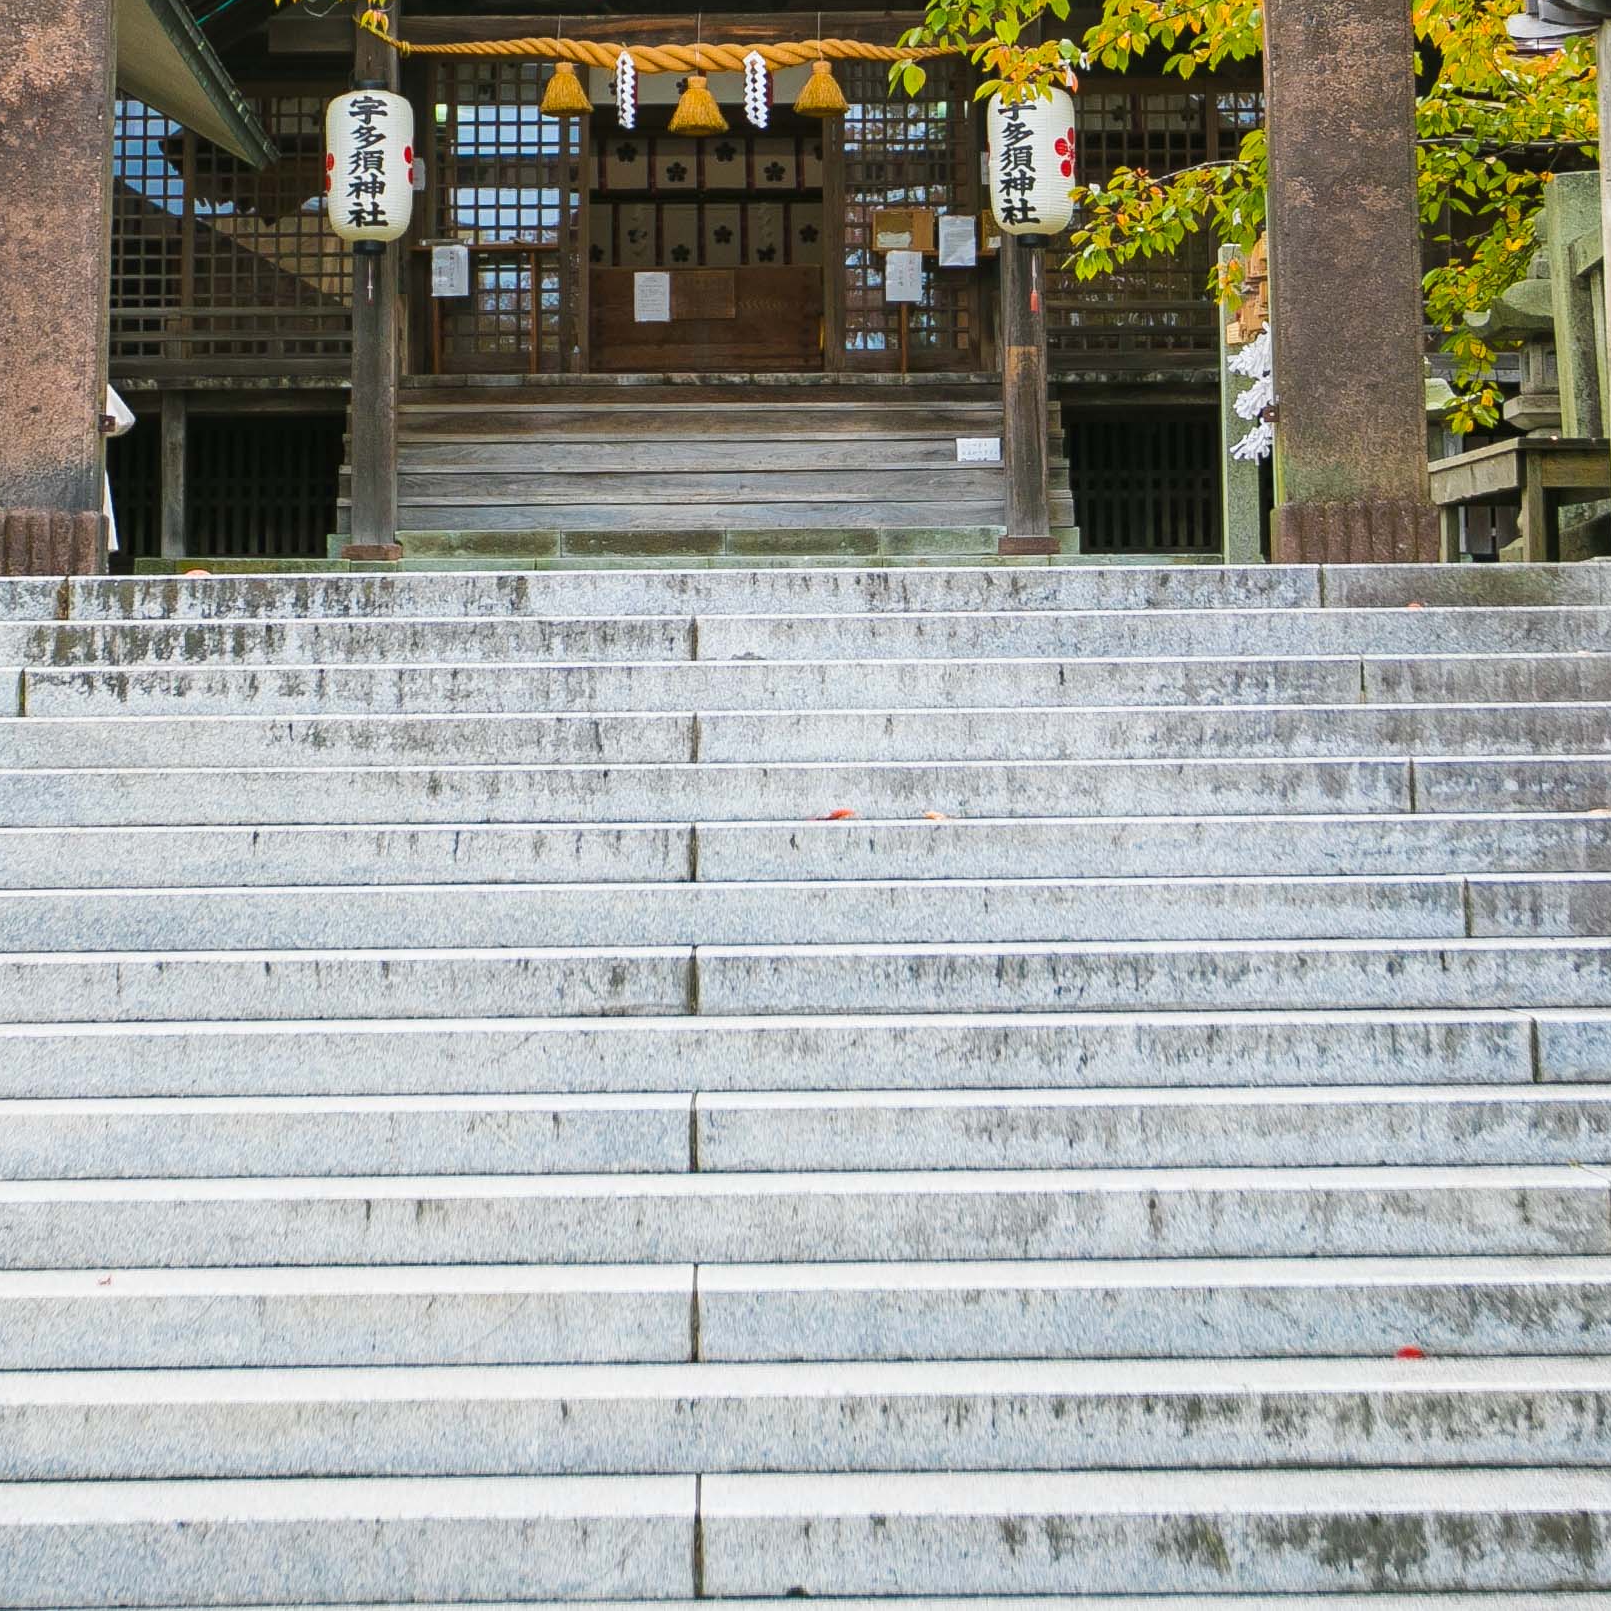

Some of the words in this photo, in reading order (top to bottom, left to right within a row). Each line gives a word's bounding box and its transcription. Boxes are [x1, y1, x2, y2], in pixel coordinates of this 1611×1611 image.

[346, 95, 389, 228] 宇多須神社
